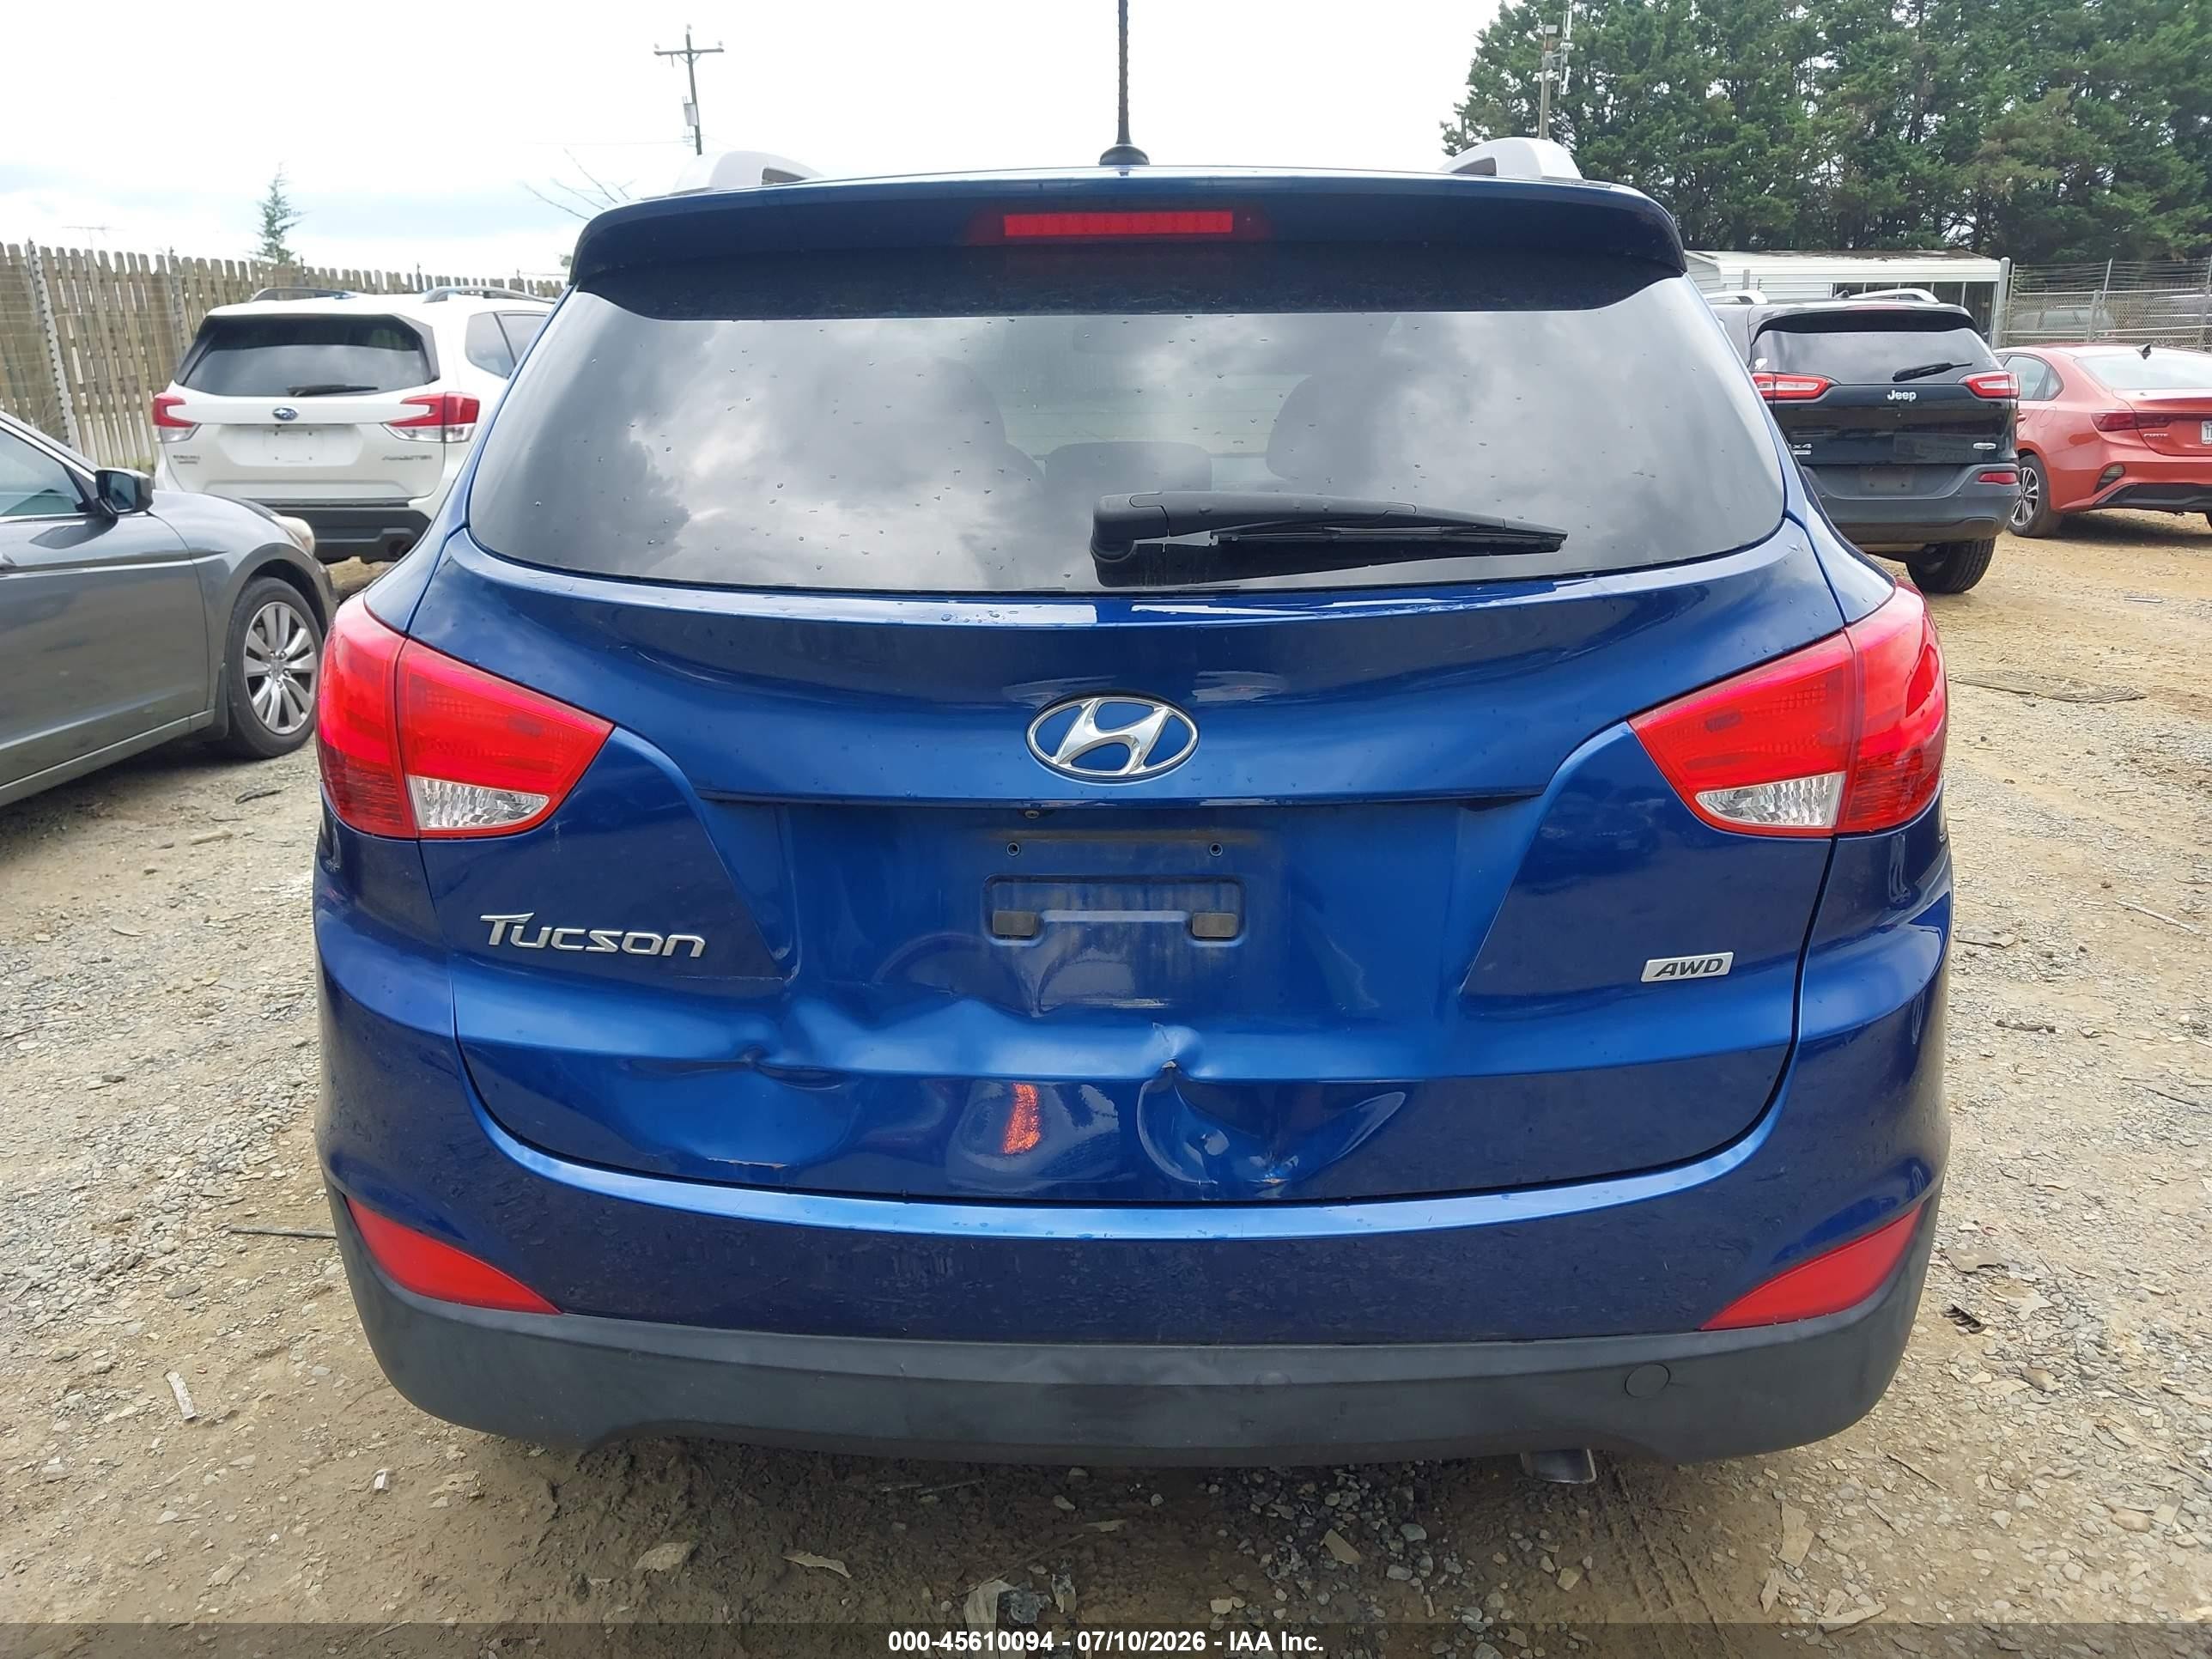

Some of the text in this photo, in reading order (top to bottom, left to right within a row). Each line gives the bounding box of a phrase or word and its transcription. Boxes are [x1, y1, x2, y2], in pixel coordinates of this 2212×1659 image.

[1887, 389, 1917, 402] Jeep
[480, 912, 706, 958] Tucson
[1651, 957, 1724, 978] AWD
